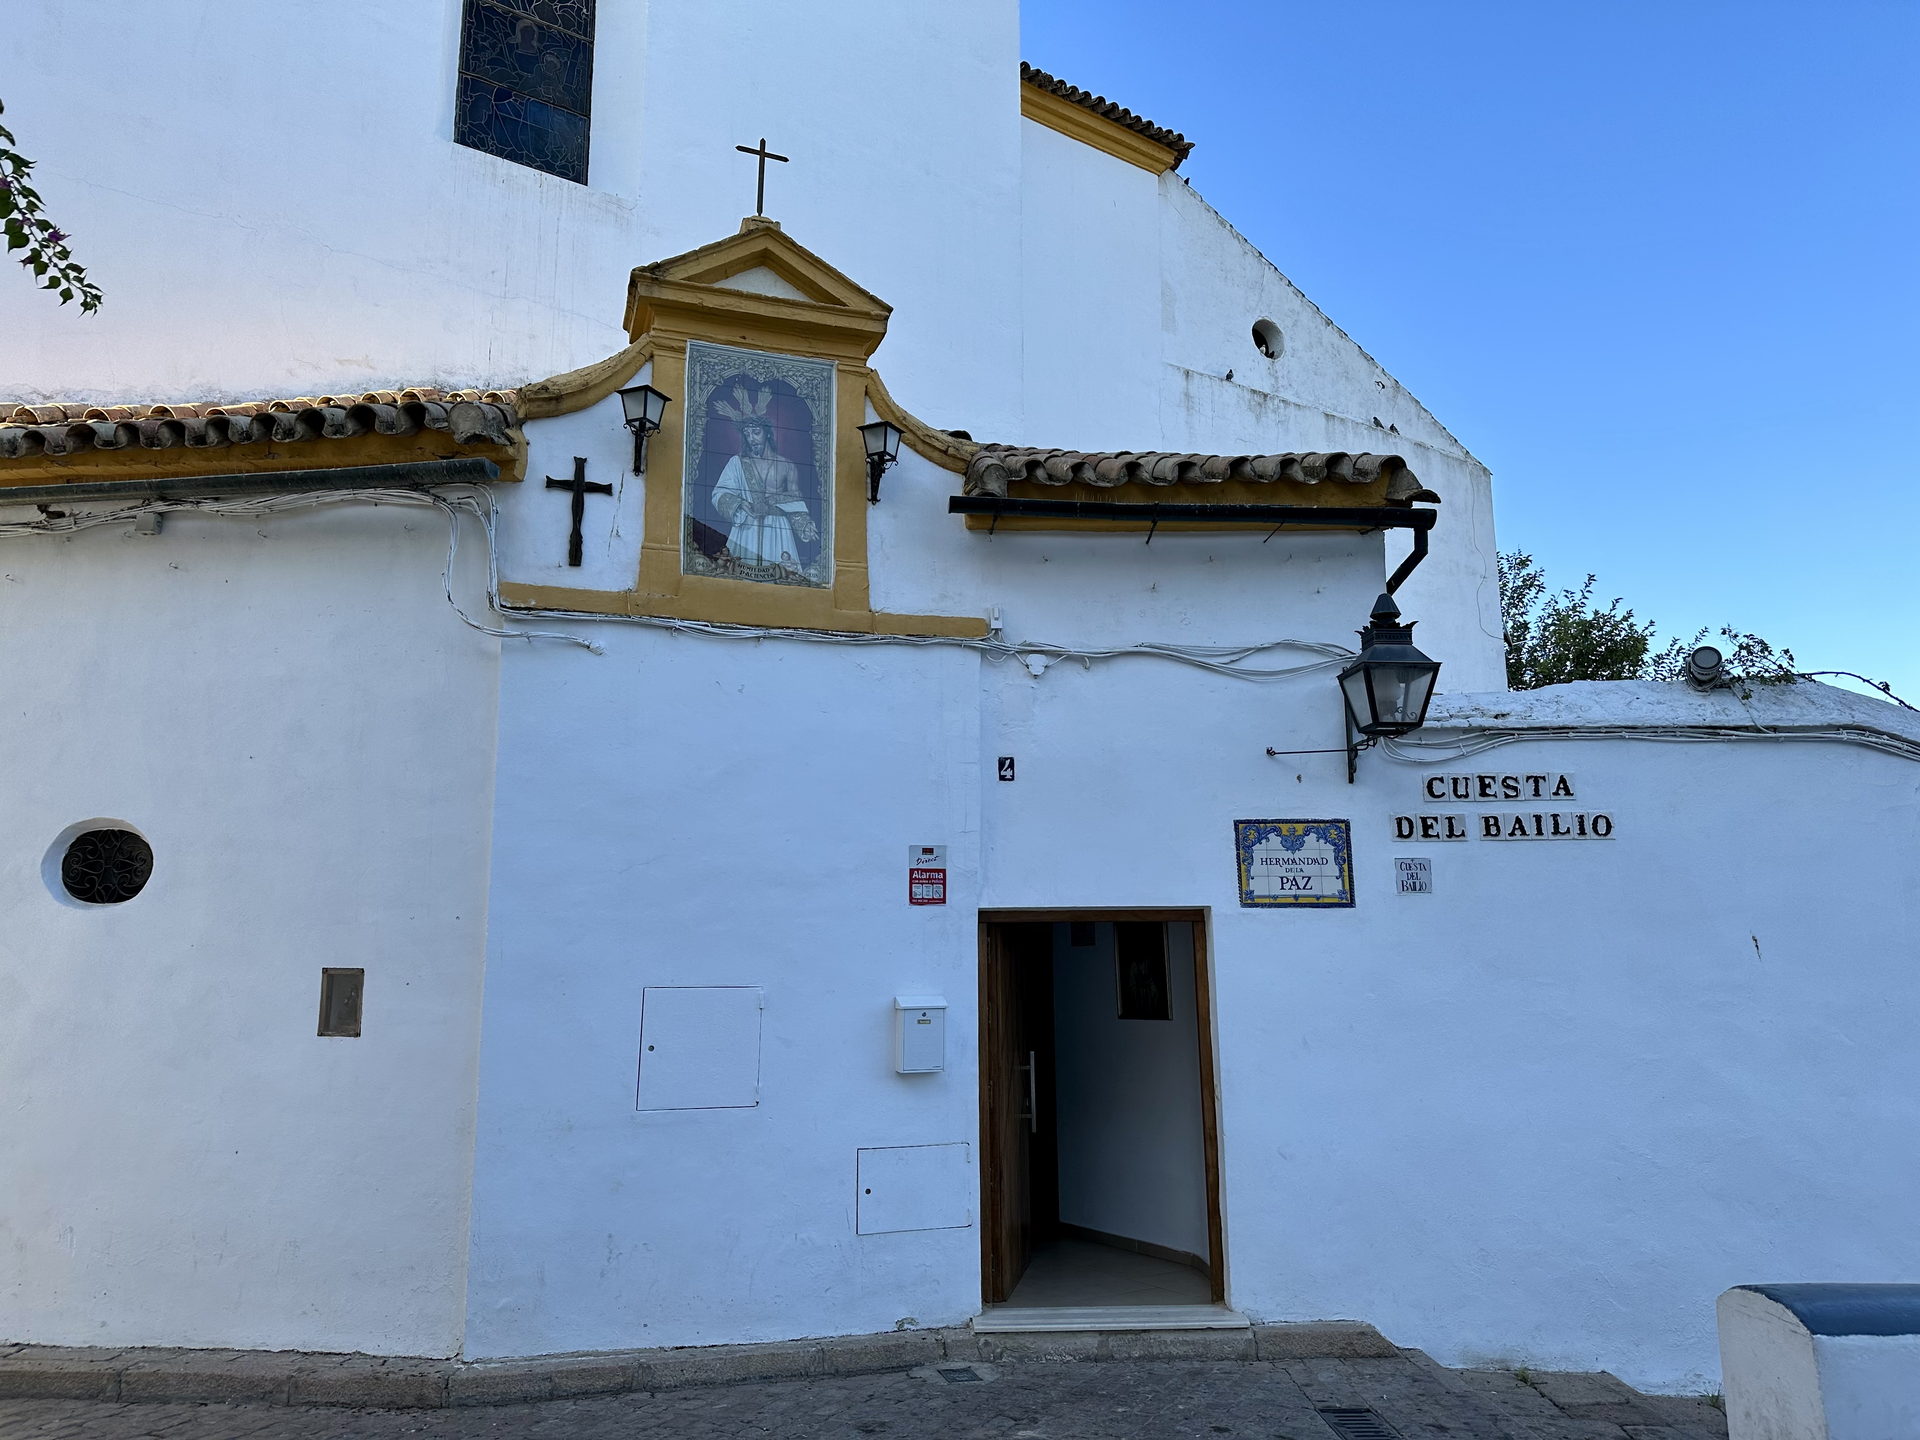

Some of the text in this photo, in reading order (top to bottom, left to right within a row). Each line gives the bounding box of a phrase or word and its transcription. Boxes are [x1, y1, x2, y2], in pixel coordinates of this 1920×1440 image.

[1000, 759, 1013, 779] 4
[1426, 774, 1574, 799] CUESTA
[1395, 813, 1613, 839] DEL BAILIO
[1260, 857, 1329, 867] HERMANDAD
[1400, 861, 1427, 871] CUESTA
[912, 870, 943, 879] Alarma
[1406, 872, 1421, 881] DEL
[1279, 876, 1313, 891] PAZ
[1401, 880, 1427, 892] BAILIO
